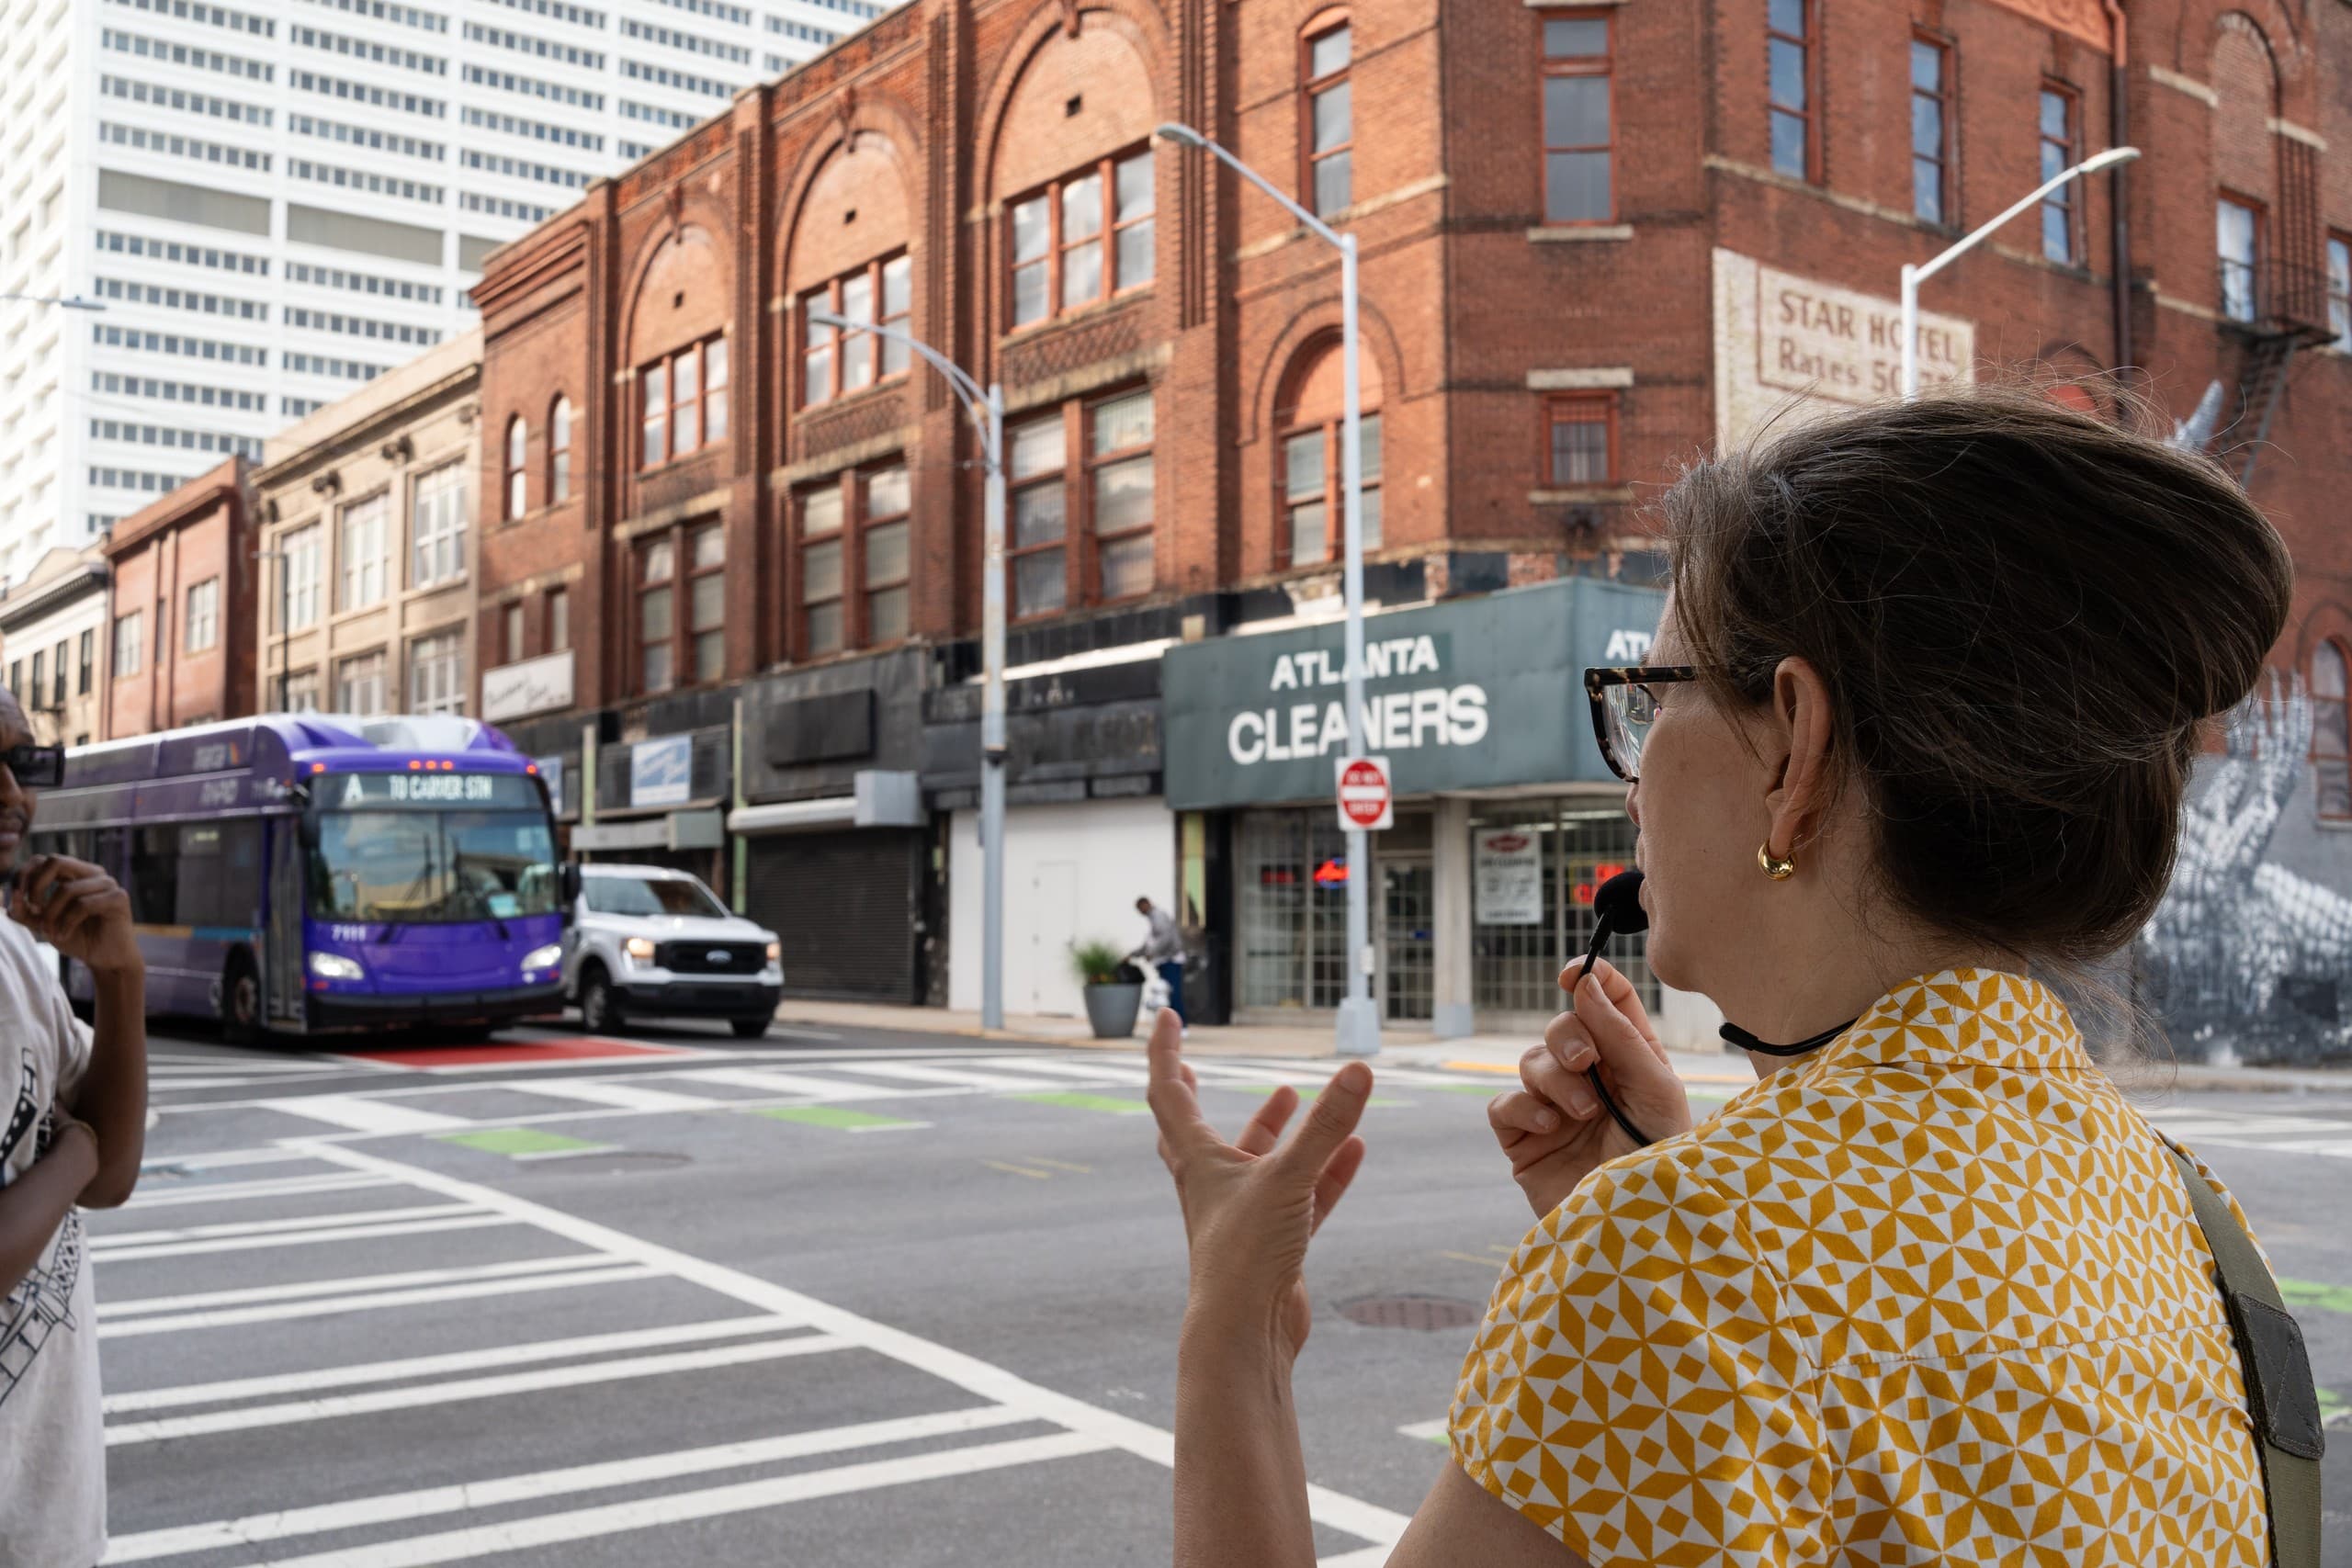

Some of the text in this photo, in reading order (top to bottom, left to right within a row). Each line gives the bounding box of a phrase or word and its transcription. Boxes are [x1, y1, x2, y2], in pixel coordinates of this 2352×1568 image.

[1779, 291, 1854, 340] STAR
[1779, 337, 1858, 387] Rates
[1227, 683, 1488, 765] CLEANERS
[345, 773, 364, 802] A
